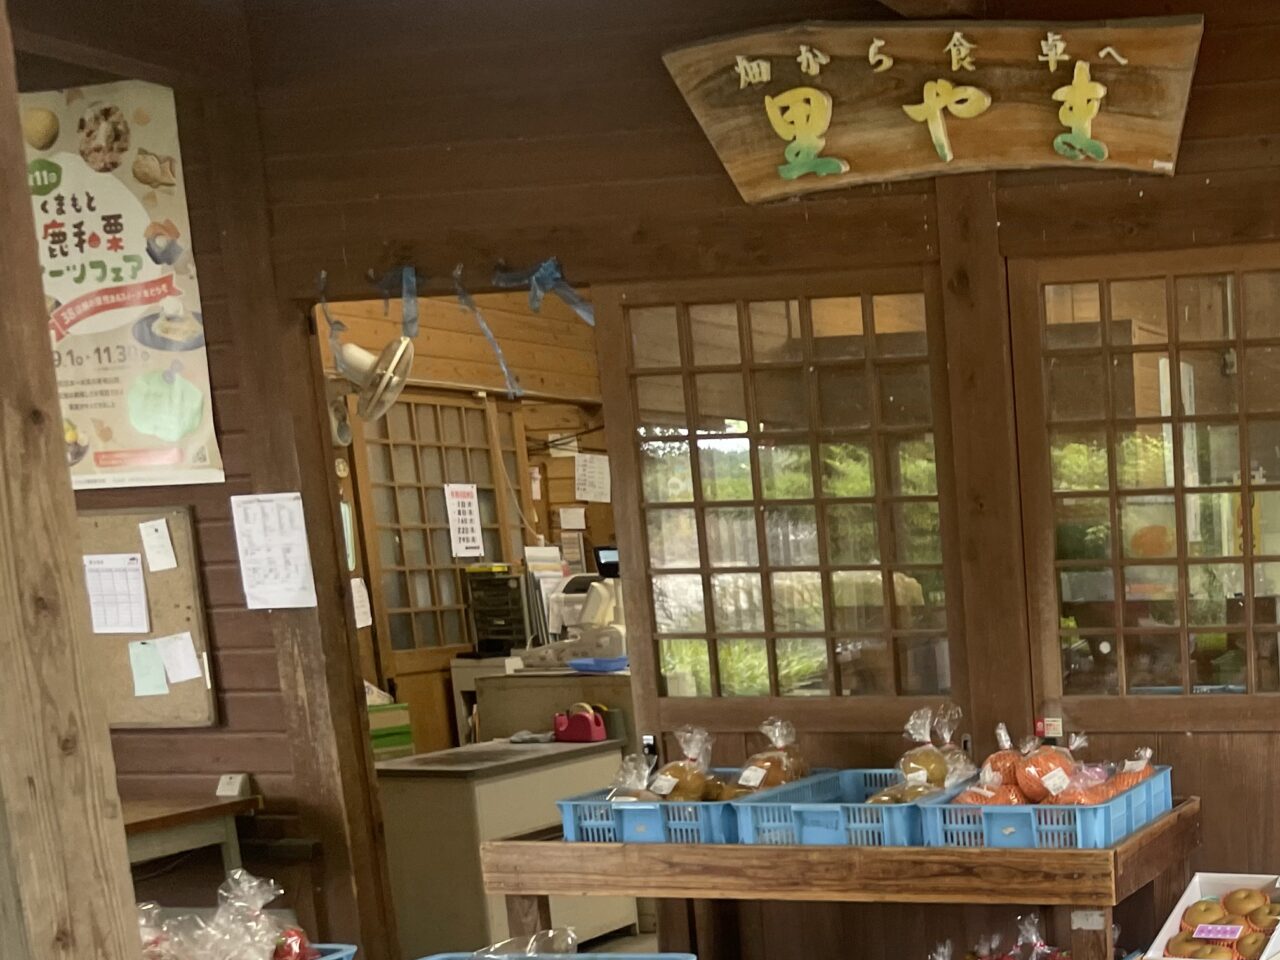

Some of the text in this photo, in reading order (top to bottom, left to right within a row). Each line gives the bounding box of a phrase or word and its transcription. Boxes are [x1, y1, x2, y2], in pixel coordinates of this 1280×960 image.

[734, 31, 1128, 89] 畑から食卓へ
[40, 191, 97, 216] くまもと
[41, 254, 144, 285] ーツフェア
